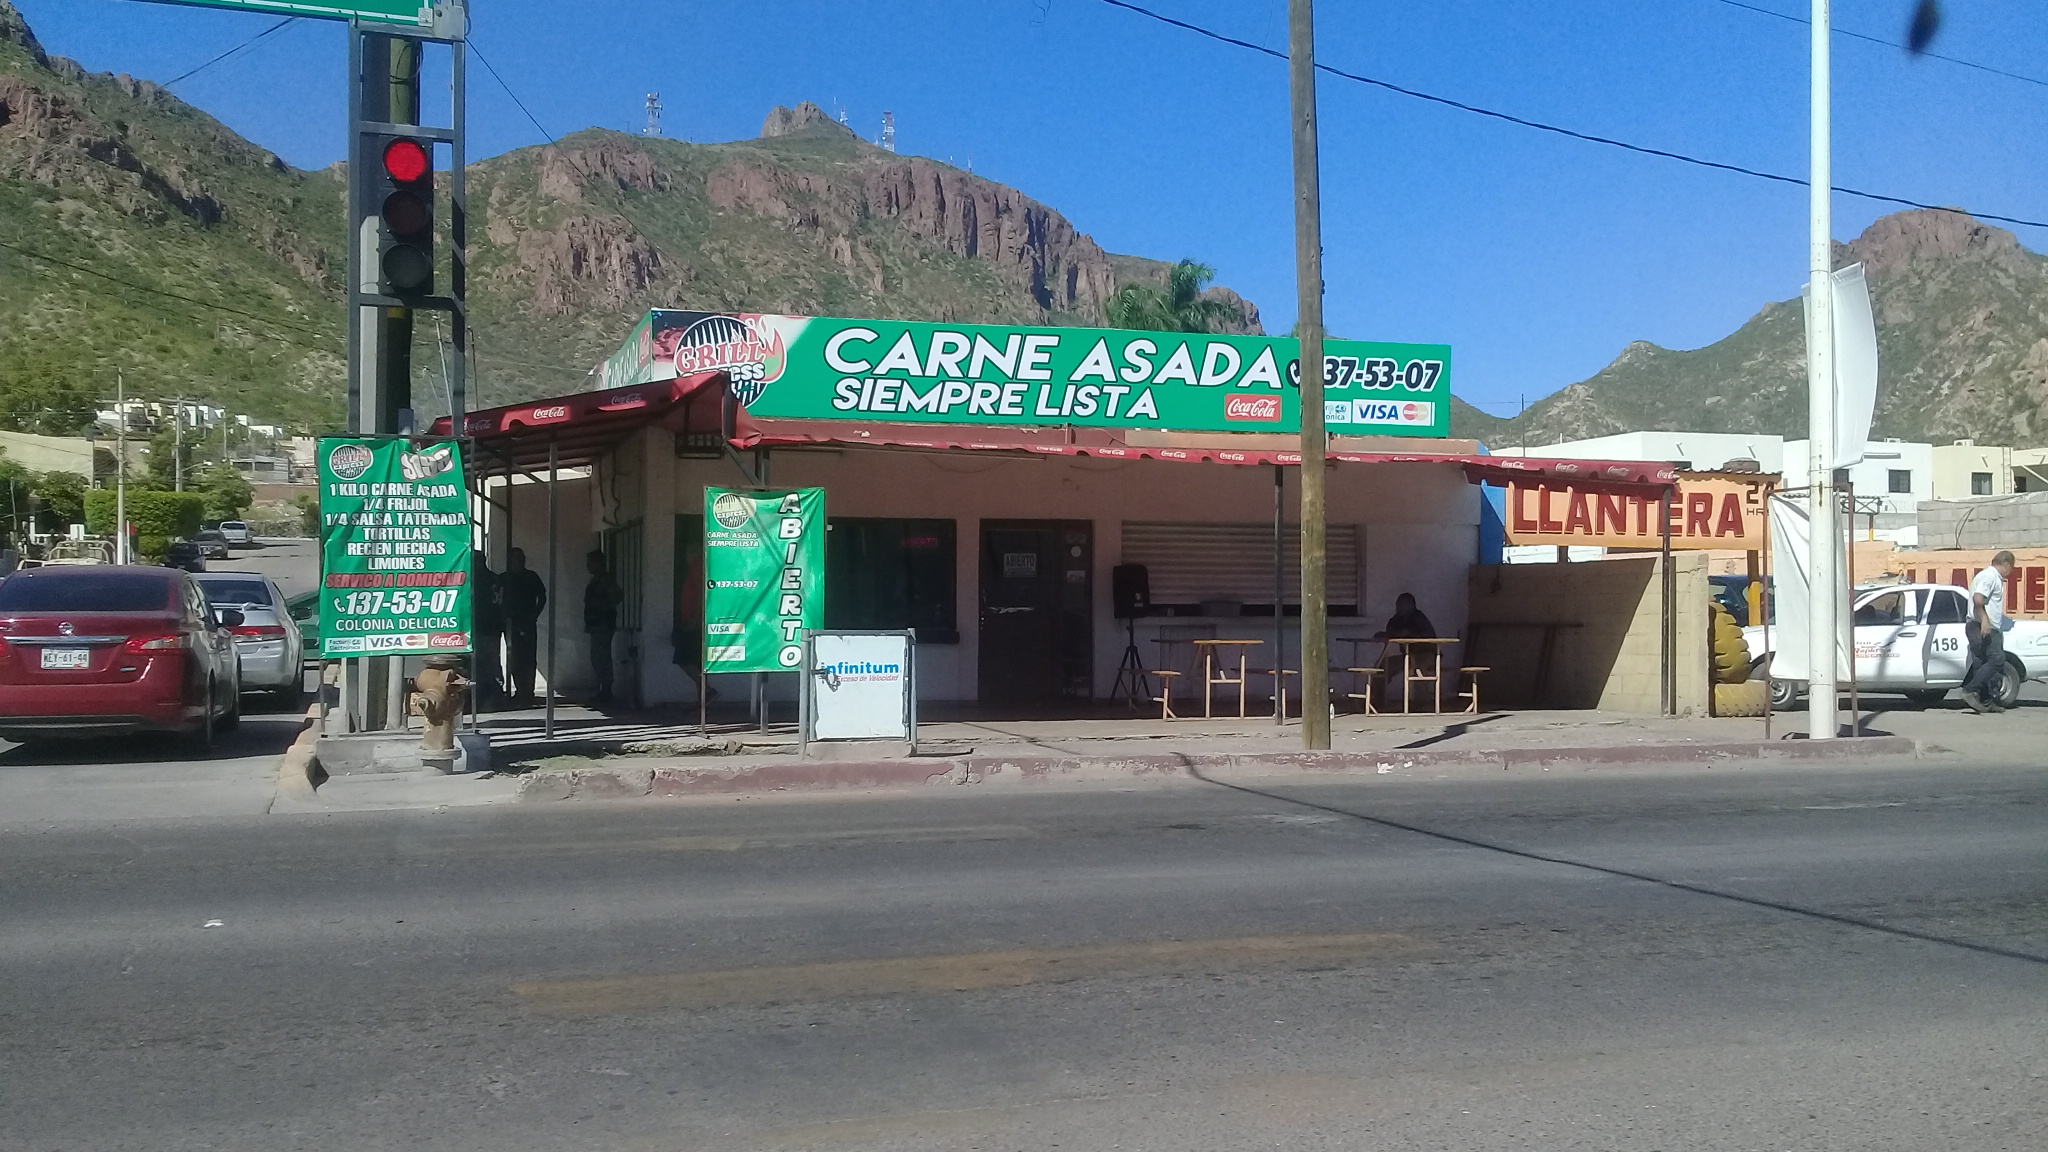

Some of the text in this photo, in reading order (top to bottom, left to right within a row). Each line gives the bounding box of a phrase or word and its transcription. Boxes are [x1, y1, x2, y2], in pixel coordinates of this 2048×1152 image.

[676, 341, 765, 371] GRILL
[824, 328, 1283, 388] CARNE ASADA
[1323, 356, 1443, 391] 37-53-07
[832, 378, 1159, 419] SIEMPRE LISTA
[533, 406, 565, 420] Coca-Cola
[1227, 398, 1276, 419] Coca-Cola
[1357, 403, 1399, 421] VISA
[1220, 452, 1245, 461] Coca-Cola
[330, 483, 458, 498] 1 KILO CARNE ASADA
[363, 498, 430, 511] 1/4 FRIJOL
[1513, 484, 1745, 537] LLANTERA
[1746, 507, 1770, 516] HR
[325, 513, 466, 526] 1/4 SALSA TATEMADA
[363, 527, 431, 540] TORTILLAS
[347, 542, 445, 555] RECIEN HECHAS
[368, 557, 425, 570] LIMONES
[1005, 555, 1035, 566] ABIERTO
[385, 574, 394, 587] A
[397, 571, 466, 586] DOMICILIO
[716, 580, 758, 588] 137-53-07
[778, 492, 803, 668] ABIERTO
[346, 590, 458, 615] 137-53-07
[336, 617, 458, 632] COLONIA DELICIAS
[710, 625, 730, 633] VISA
[368, 637, 403, 648] VISA
[430, 635, 464, 647] Coca-Cola
[1932, 637, 1958, 652] 158
